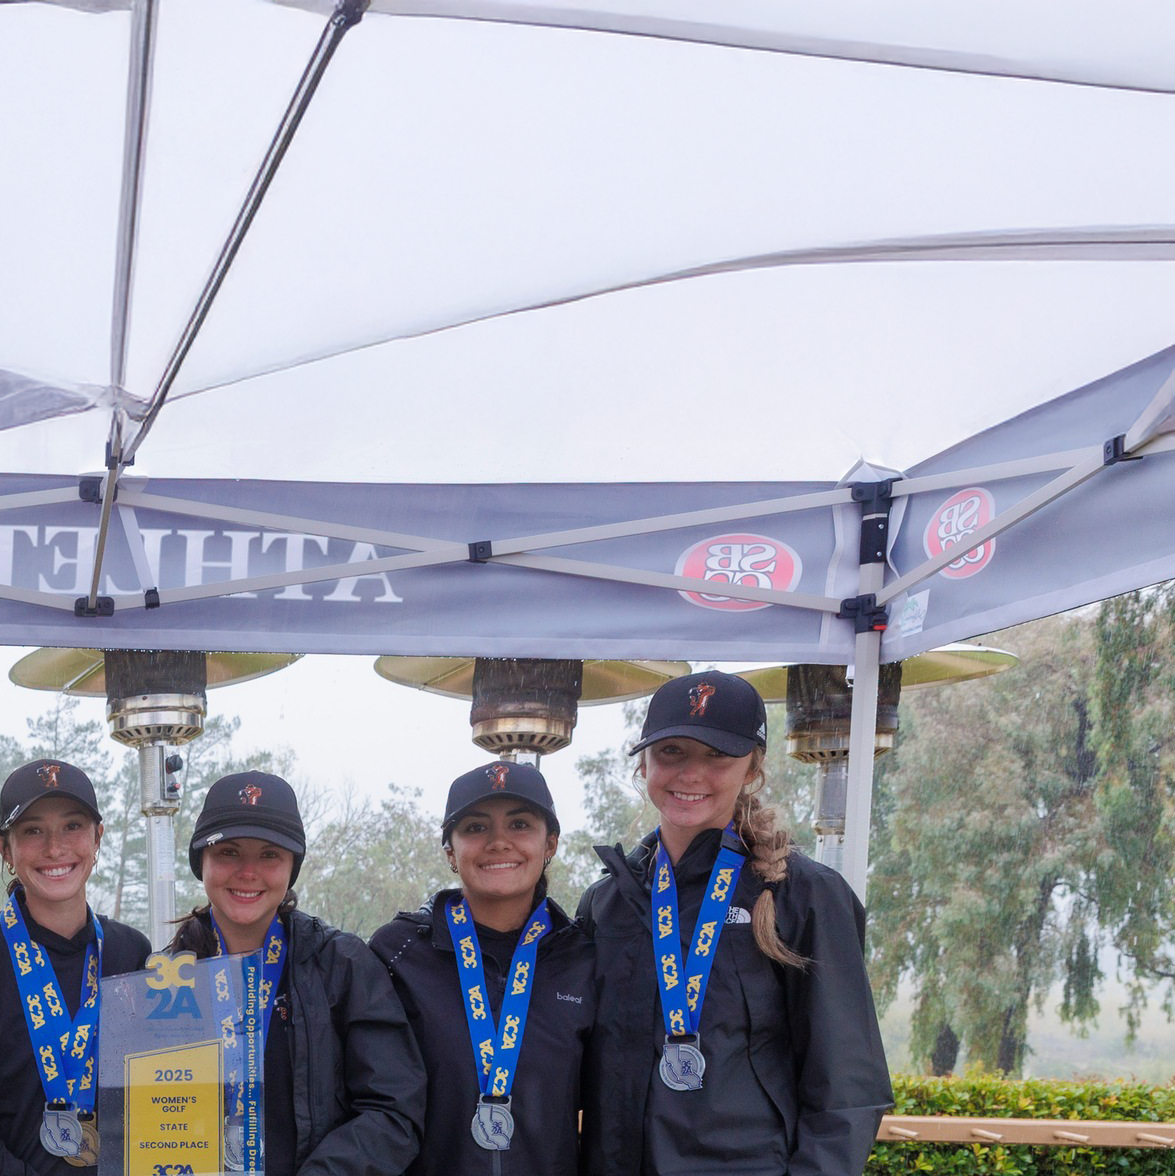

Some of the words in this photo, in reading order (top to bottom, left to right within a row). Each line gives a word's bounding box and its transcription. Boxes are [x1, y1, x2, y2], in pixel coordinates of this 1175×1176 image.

[658, 864, 671, 893] 3C2A
[711, 868, 734, 902] 3C2A
[522, 921, 546, 946] 3C2A
[658, 905, 673, 939] 3C2A
[695, 921, 718, 957] 3C2A
[14, 942, 32, 976] 3C2A
[265, 936, 282, 964] 3C2A
[459, 936, 478, 969] 3C2A
[145, 953, 195, 990] 3C
[215, 969, 229, 1002] 3C2A
[511, 961, 530, 995] 3C2A
[661, 954, 679, 991] 3C2A
[43, 982, 63, 1017] 3C2A
[146, 986, 203, 1020] 2A
[246, 966, 257, 1016] Providing
[468, 985, 487, 1021] 3C2A
[557, 992, 582, 1004] baleaf
[27, 994, 46, 1030] 3C2A
[669, 1009, 686, 1036] 3C2
[71, 1024, 91, 1059] 3C2A
[221, 1015, 237, 1049] 3C2A
[501, 1014, 520, 1050] 3C2A
[39, 1045, 59, 1082] 3C2A
[155, 1069, 193, 1082] 2025
[492, 1067, 509, 1097] 3C2
[151, 1096, 197, 1104] WOMEN'S
[160, 1123, 188, 1131] STATE
[246, 1101, 257, 1147] Fulfilling
[139, 1141, 178, 1149] SECOND
[180, 1141, 209, 1149] PLACE
